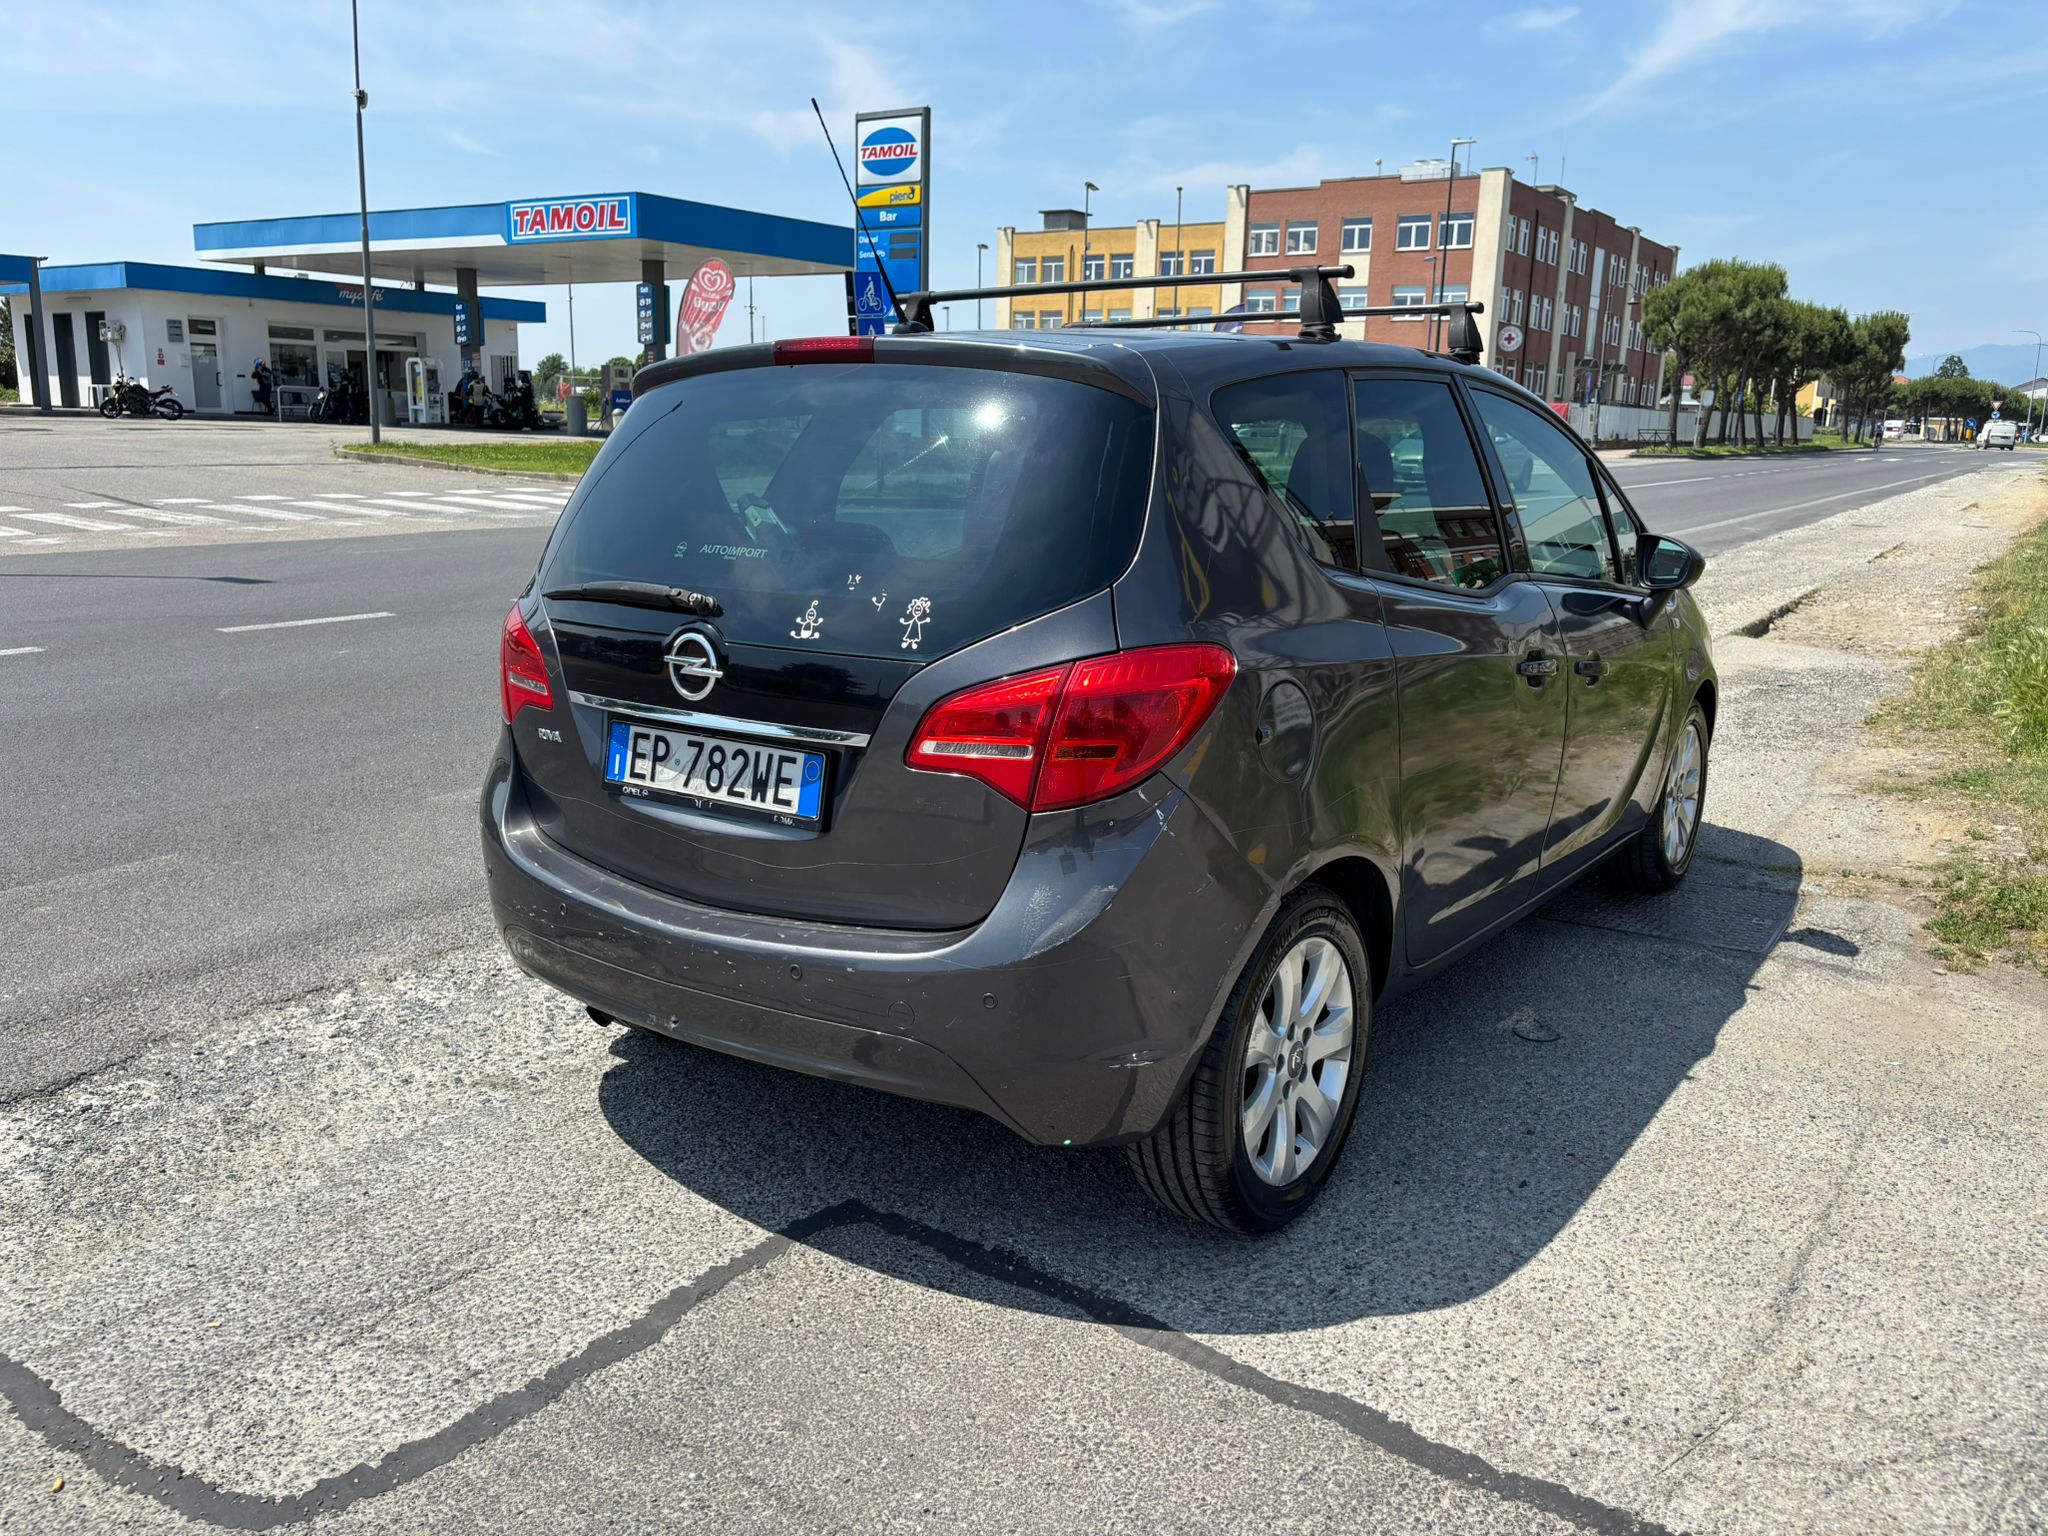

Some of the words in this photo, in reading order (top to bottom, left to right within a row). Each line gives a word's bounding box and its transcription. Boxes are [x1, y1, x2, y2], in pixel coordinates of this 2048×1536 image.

[861, 143, 918, 160] TAMOIL
[513, 201, 627, 235] TAMOIL
[879, 211, 898, 222] Bar
[699, 544, 768, 559] AUTOIMPORT
